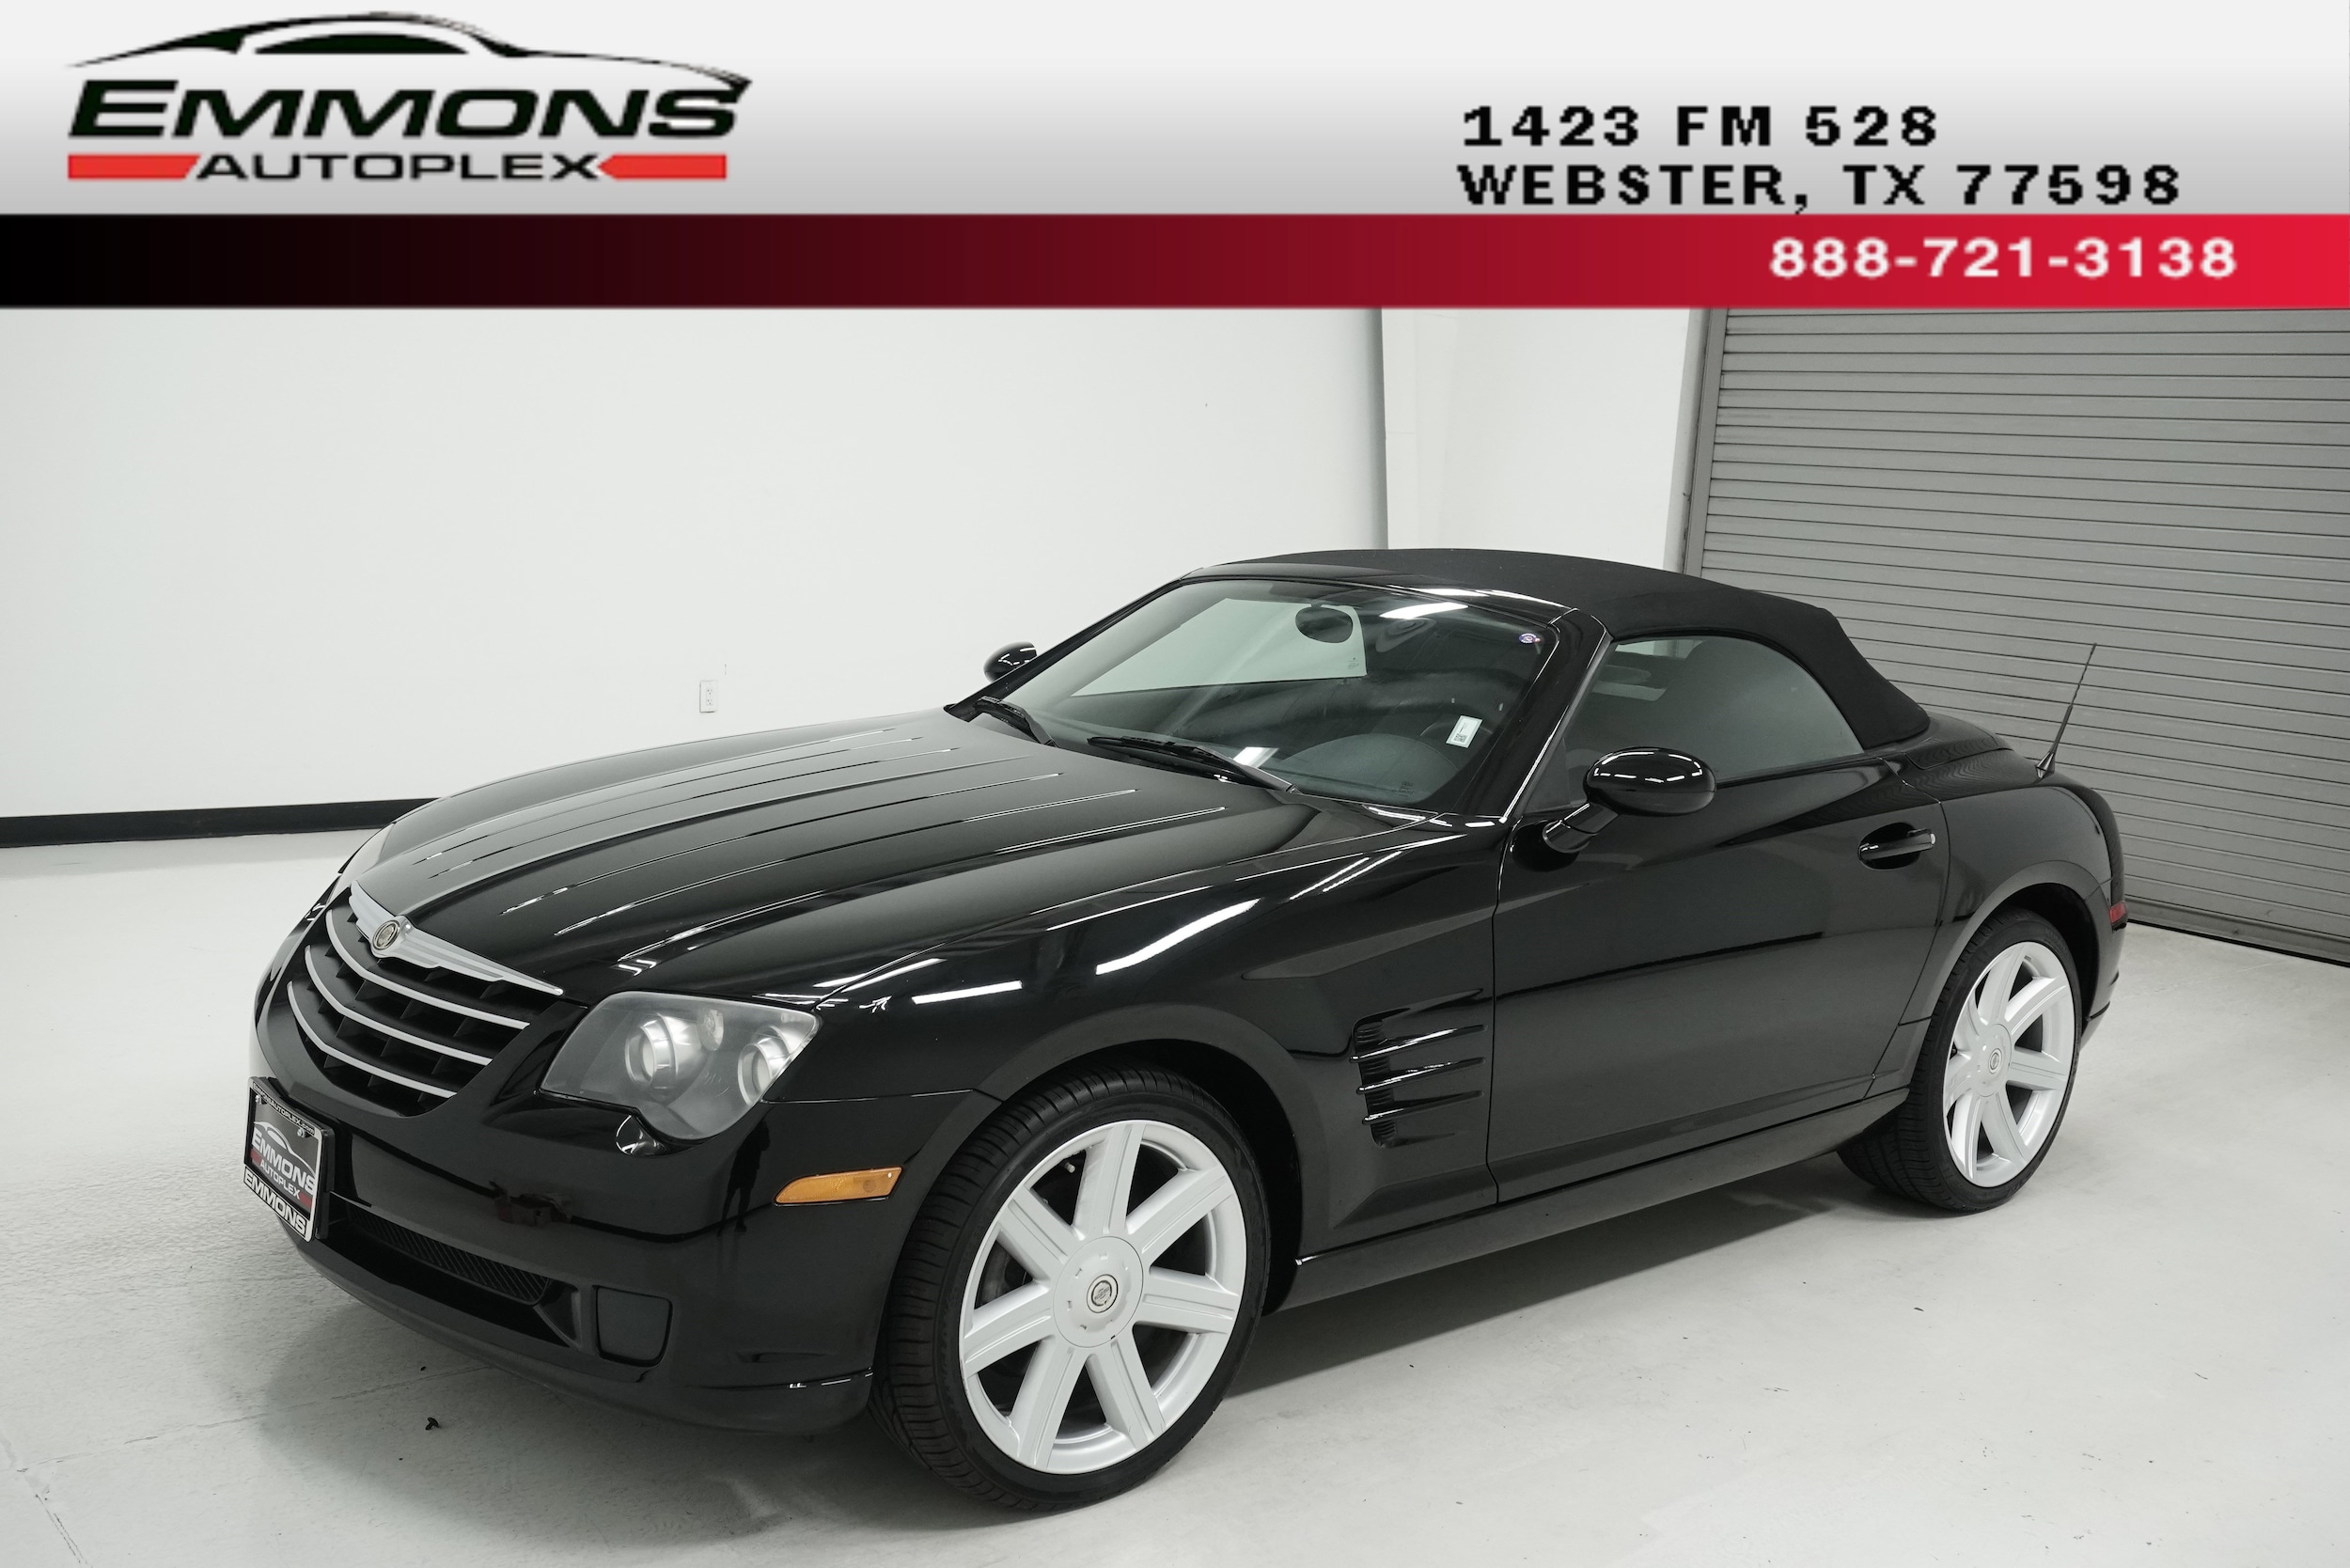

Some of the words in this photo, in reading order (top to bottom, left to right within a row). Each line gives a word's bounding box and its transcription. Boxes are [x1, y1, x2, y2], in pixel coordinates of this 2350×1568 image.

[251, 1127, 316, 1196] EMMONS
[259, 1160, 301, 1200] AUTOPLEX
[244, 1168, 306, 1236] EMMONS
